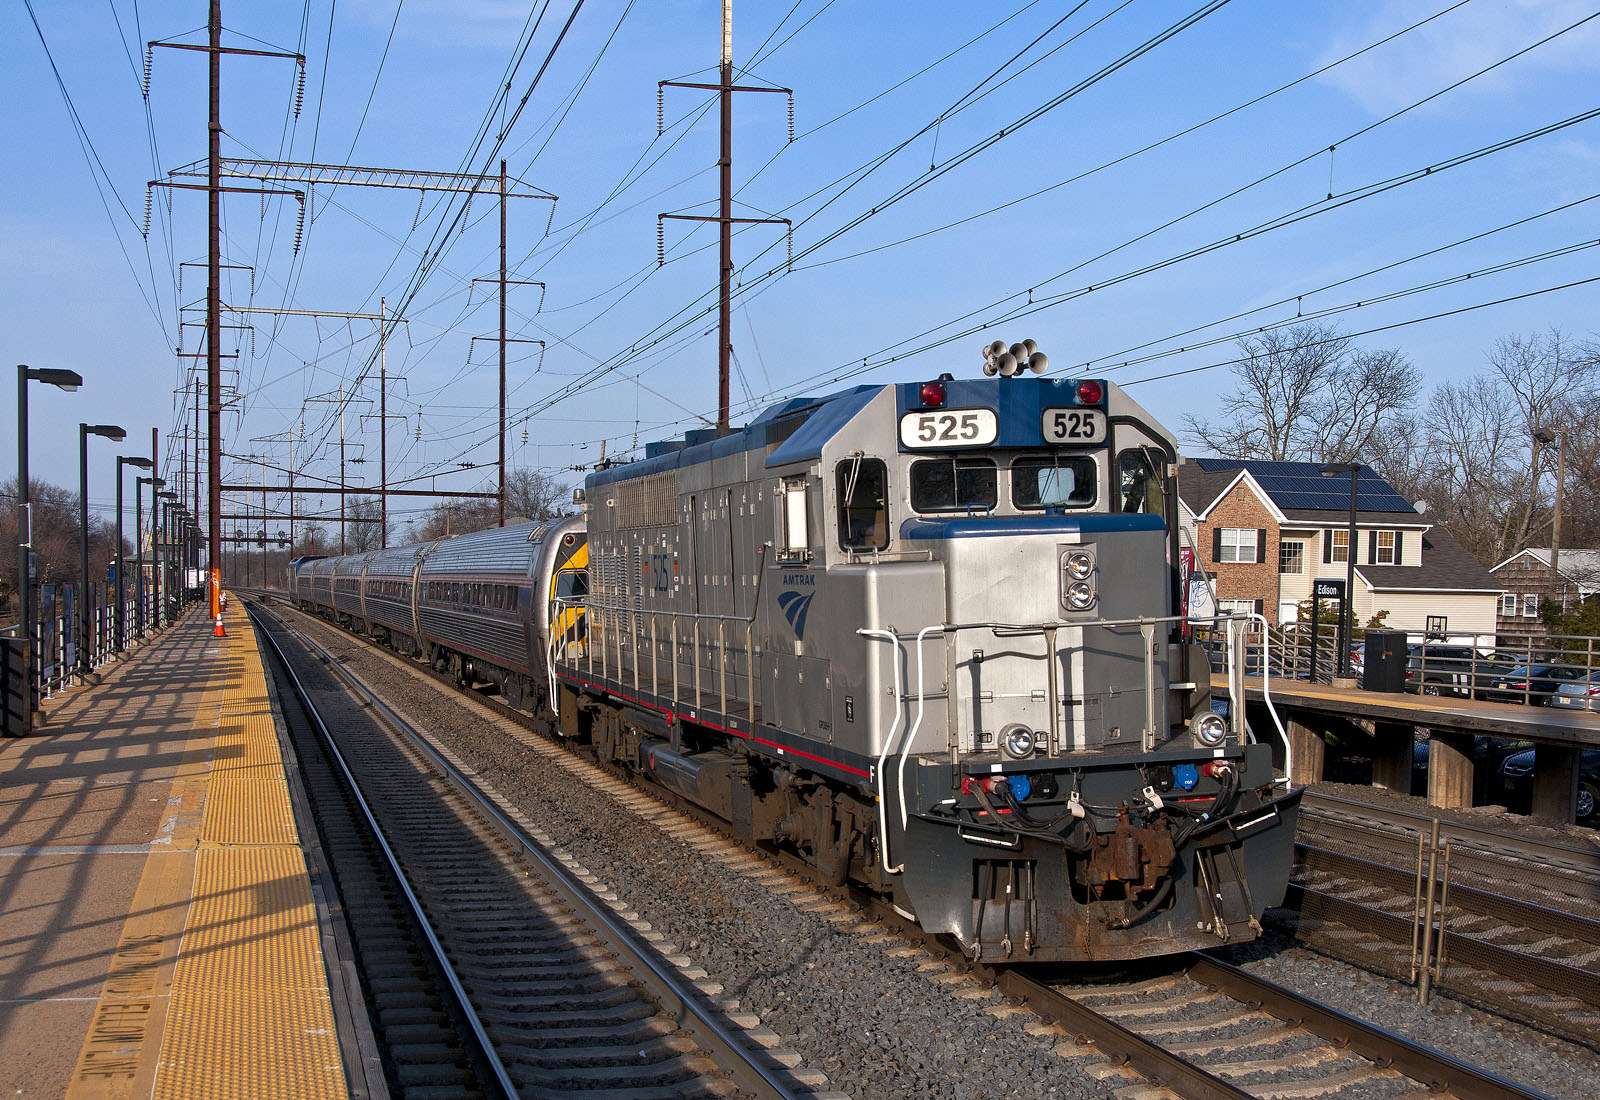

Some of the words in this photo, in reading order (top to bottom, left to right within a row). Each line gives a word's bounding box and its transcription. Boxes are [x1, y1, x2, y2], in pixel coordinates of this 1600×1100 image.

[918, 414, 980, 442] 525
[1054, 413, 1095, 438] 525
[653, 554, 669, 593] 525
[783, 574, 816, 586] AMTRAK
[1317, 584, 1337, 595] Edison
[869, 765, 875, 784] F
